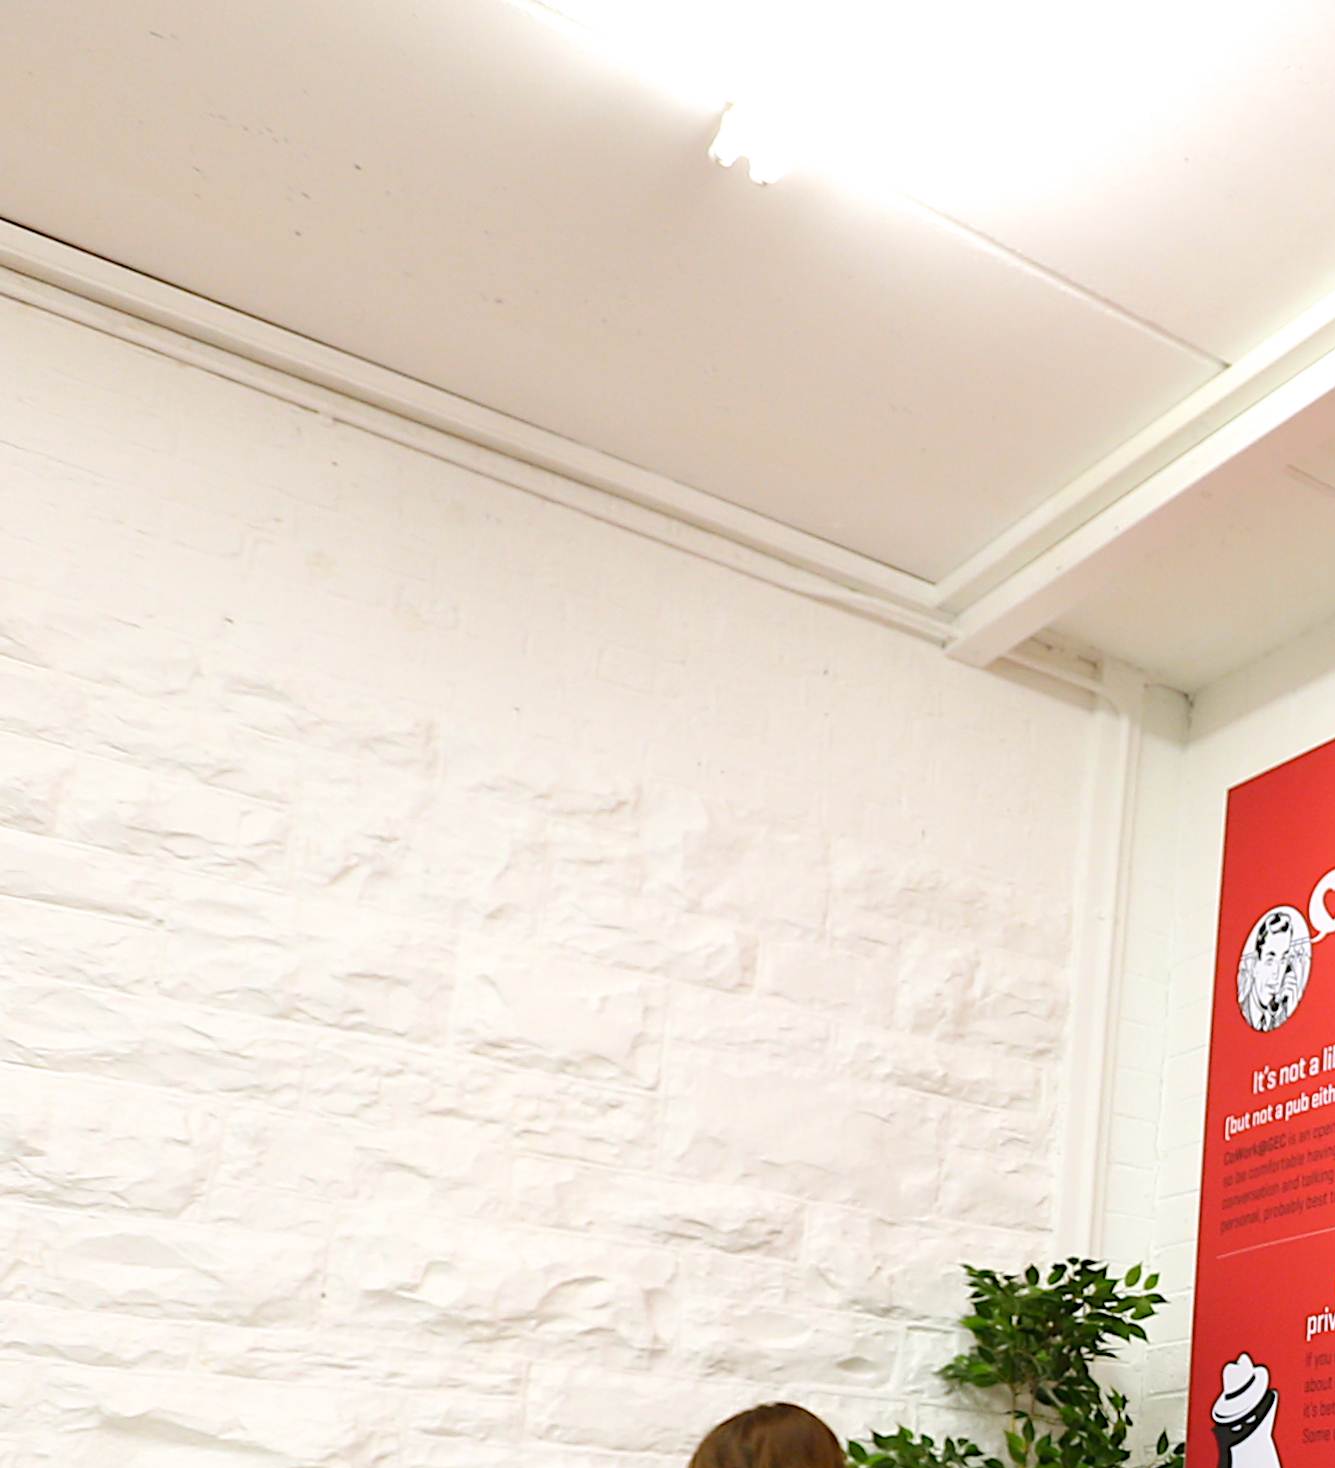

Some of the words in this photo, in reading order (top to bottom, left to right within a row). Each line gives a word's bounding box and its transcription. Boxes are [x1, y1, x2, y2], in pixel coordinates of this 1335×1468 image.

[1254, 1066, 1276, 1093] It's
[1280, 1058, 1305, 1084] not
[1310, 1057, 1319, 1075] a
[1253, 1105, 1272, 1125] not
[1275, 1104, 1283, 1119] a
[1285, 1093, 1309, 1120] pub
